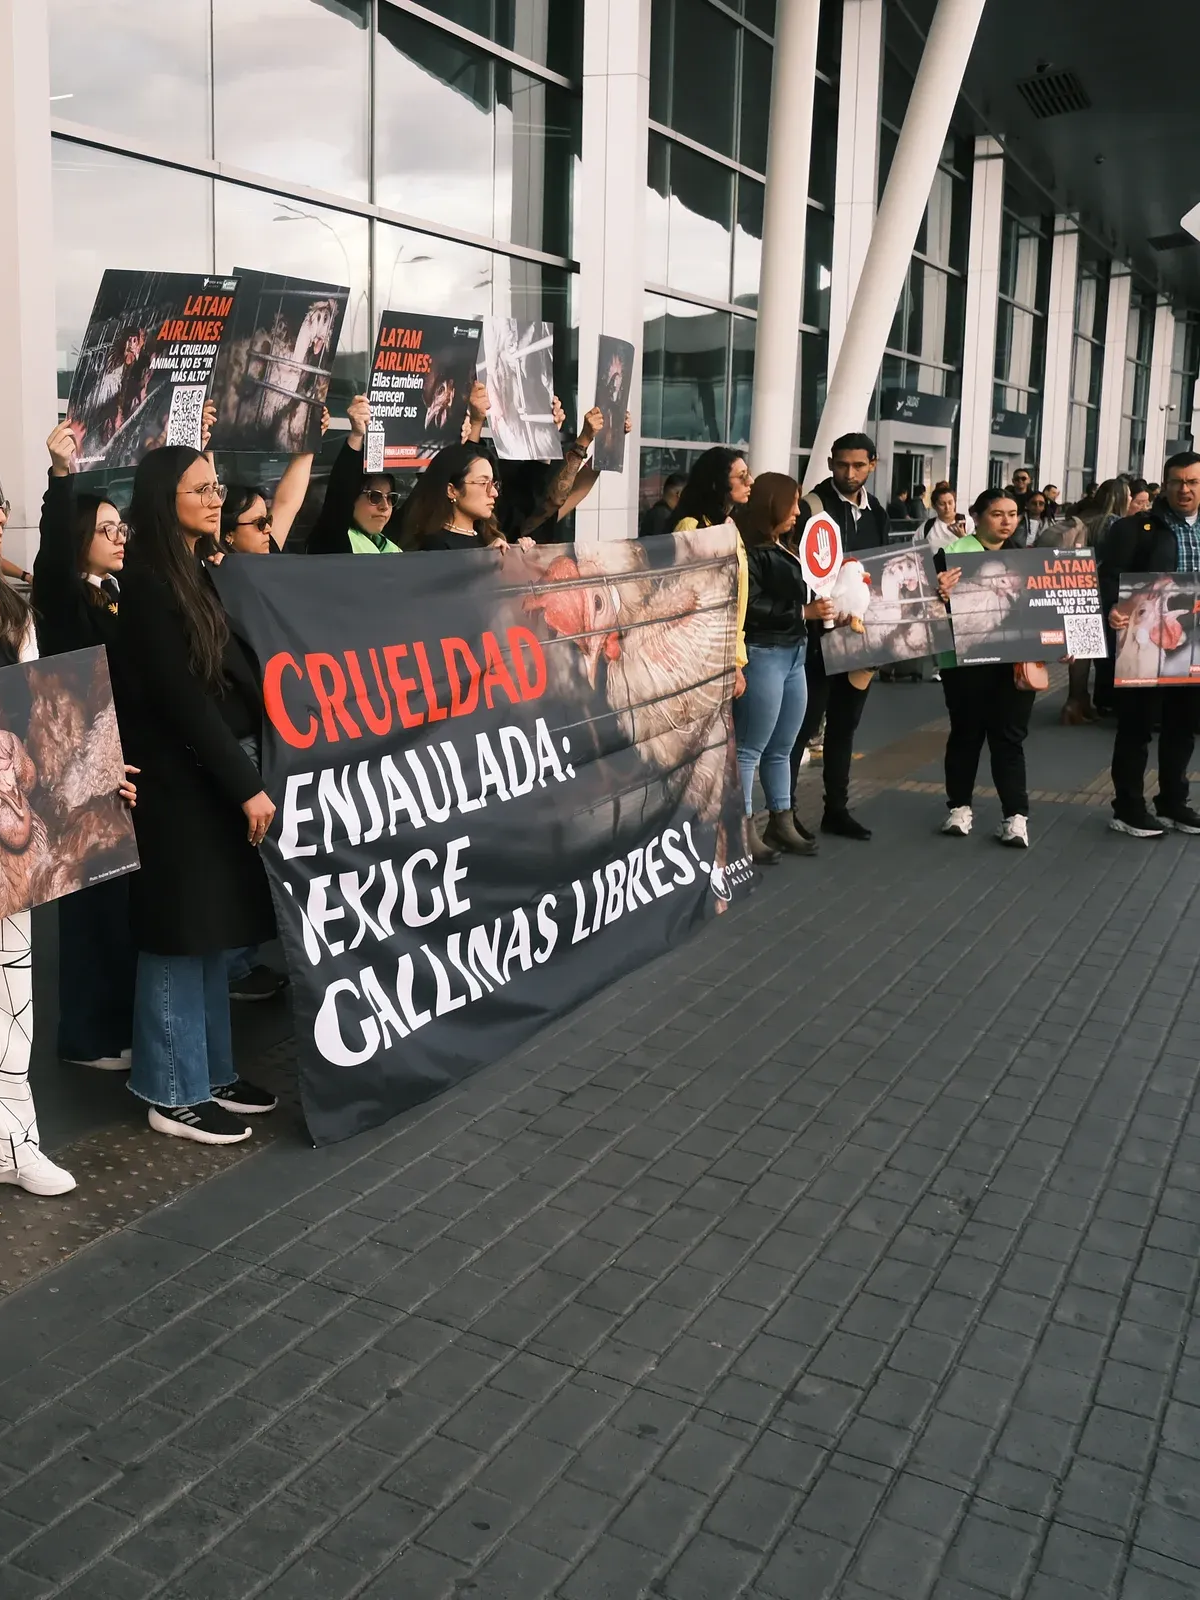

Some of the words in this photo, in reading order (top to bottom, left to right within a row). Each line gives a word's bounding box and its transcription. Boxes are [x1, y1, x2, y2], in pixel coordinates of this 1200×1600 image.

[183, 295, 234, 317] LATAM
[157, 319, 224, 341] AIRLINES:
[380, 327, 422, 349] LATAM
[169, 344, 179, 356] LA
[180, 344, 217, 355] CRUELDAD
[149, 358, 179, 369] ANIMAL
[180, 357, 192, 369] NO
[193, 358, 201, 368] ES
[375, 351, 432, 373] AIRLINES:
[170, 367, 188, 382] MÁS
[372, 373, 390, 387] Ellas
[391, 373, 424, 389] también
[370, 390, 405, 403] merecen
[369, 403, 403, 417] extender
[403, 406, 418, 418] sus
[368, 417, 385, 431] alas.
[1044, 559, 1096, 573] LATAM
[1026, 574, 1097, 590] AIRLINES:
[1045, 590, 1056, 598] LA
[1057, 589, 1098, 597] CRUELDAD
[1029, 598, 1062, 607] ANIMAL
[1057, 604, 1074, 614] MÁS
[263, 625, 547, 748] CRUELDAD
[278, 718, 576, 860] ENJAULADA:
[725, 857, 748, 876] OPEN
[570, 820, 711, 945] LIBRES!
